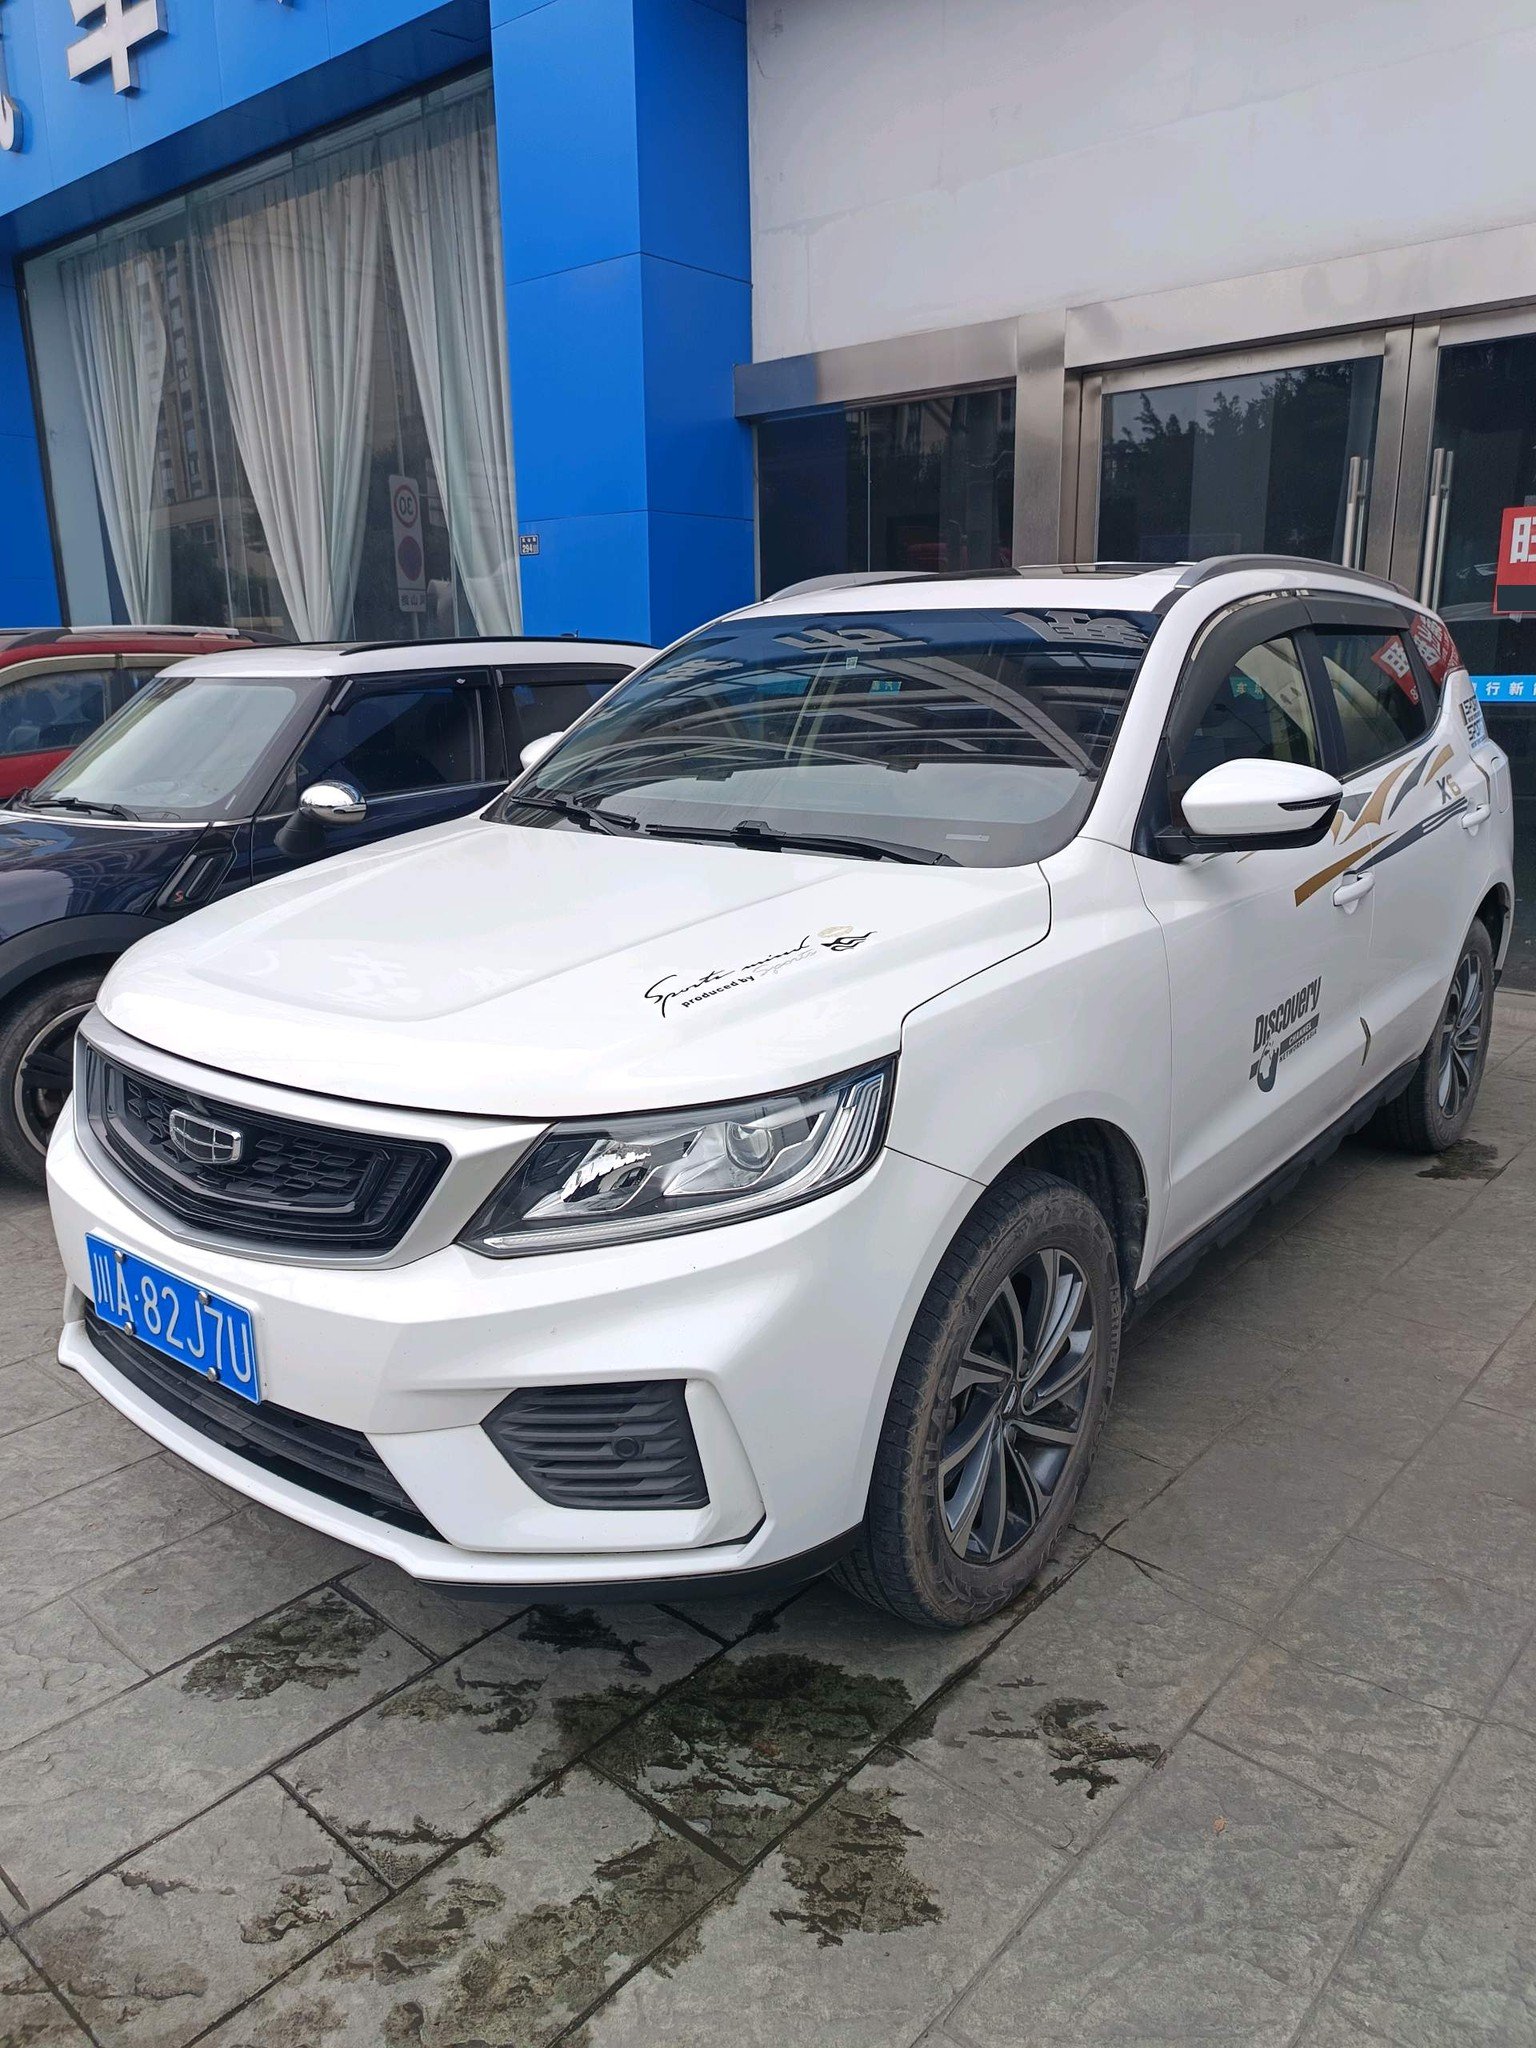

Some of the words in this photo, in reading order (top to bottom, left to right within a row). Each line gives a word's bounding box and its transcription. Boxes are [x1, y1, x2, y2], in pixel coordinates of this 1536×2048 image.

[1472, 681, 1536, 696] 行新
[741, 934, 810, 971] mind
[681, 979, 739, 1008] produced
[738, 974, 755, 985] by
